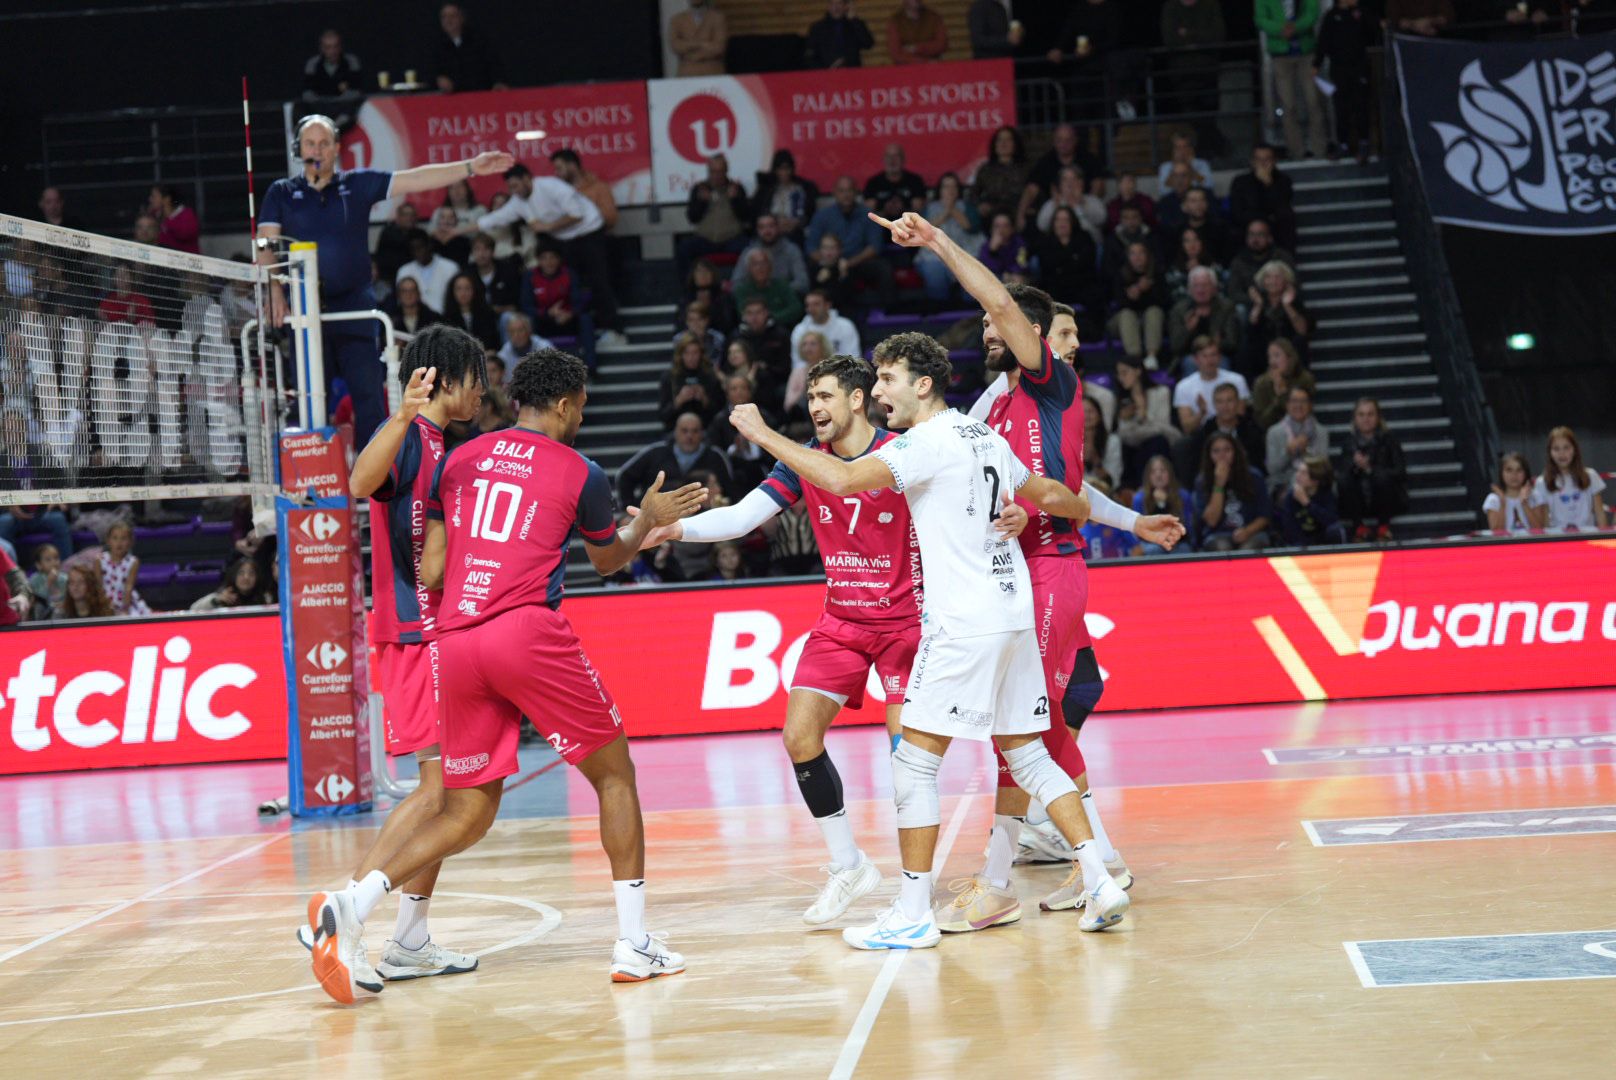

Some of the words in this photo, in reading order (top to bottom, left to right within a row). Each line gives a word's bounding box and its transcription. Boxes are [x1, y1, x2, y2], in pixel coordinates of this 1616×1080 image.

[792, 92, 864, 113] PALAIS
[870, 87, 912, 109] DES
[918, 82, 1001, 105] SPORTS
[427, 113, 499, 136] PALAIS
[506, 109, 546, 132] DES
[553, 104, 633, 129] SPORTS
[792, 120, 818, 142] ET
[825, 117, 866, 139] DES
[872, 108, 1003, 135] SPECTACLES
[428, 143, 453, 162] ET
[507, 132, 636, 161] SPECTACLES
[1028, 419, 1041, 454] CLUB
[292, 446, 328, 458] market
[492, 440, 535, 460] BALA
[494, 460, 532, 475] FORMA
[296, 474, 338, 488] AJACCIO
[983, 466, 1001, 522] 2
[412, 500, 423, 536] CLUB
[470, 478, 523, 543] 10
[843, 497, 862, 534] 7
[295, 543, 347, 555] Carrefour
[303, 553, 340, 564] market
[825, 555, 869, 568] MARINA
[870, 558, 891, 568] Viva
[465, 571, 492, 586] AVIS
[849, 581, 890, 589] CORSICA
[302, 583, 345, 594] AJACCIO
[300, 595, 333, 607] Albert
[1039, 606, 1053, 657] LUCCIONI
[302, 673, 352, 685] Carrefour
[0, 635, 259, 752] tclic
[310, 684, 347, 695] market
[311, 714, 353, 727] AJACCIO
[310, 727, 339, 740] Albert
